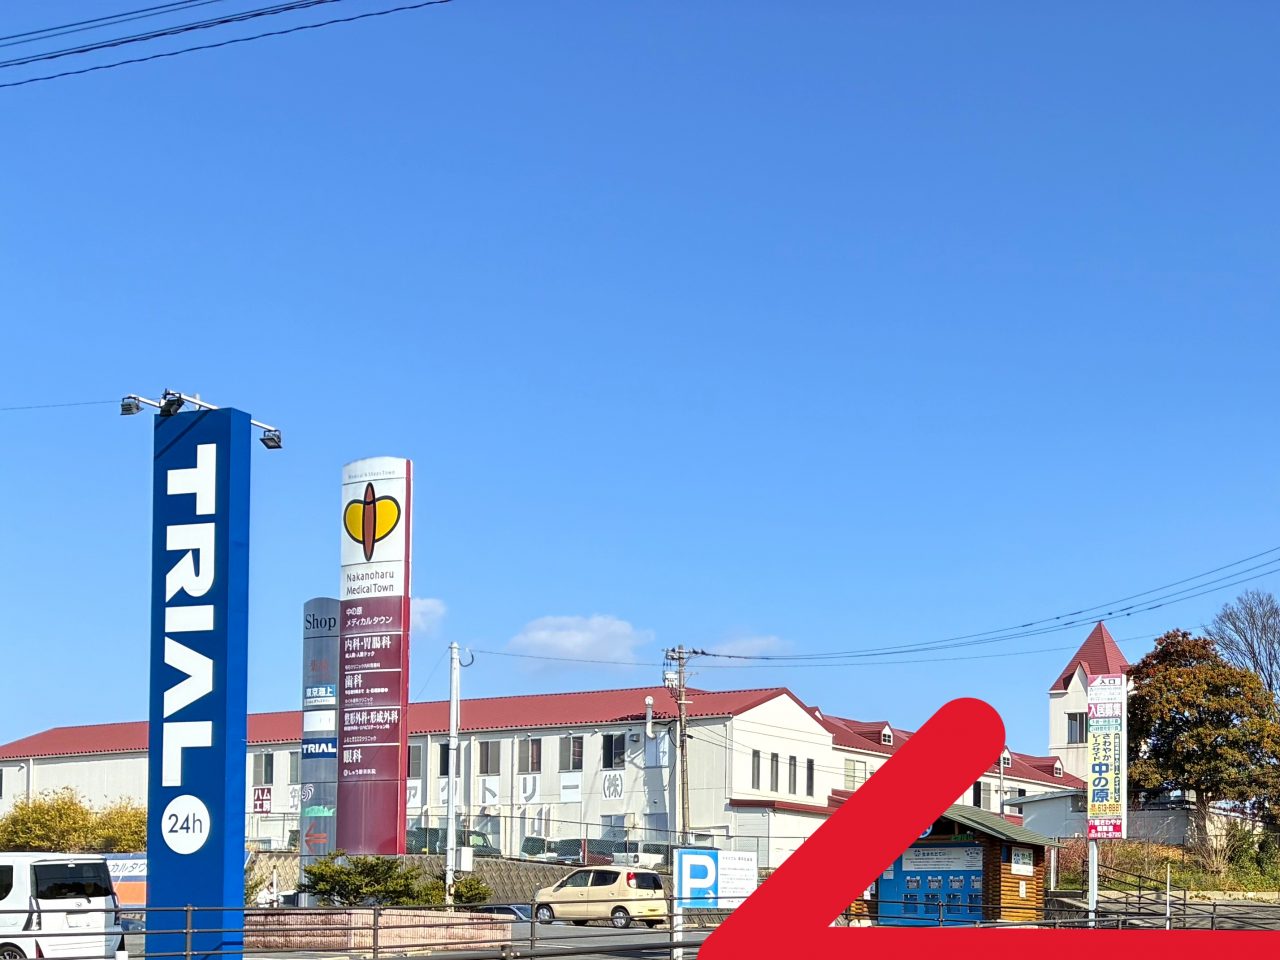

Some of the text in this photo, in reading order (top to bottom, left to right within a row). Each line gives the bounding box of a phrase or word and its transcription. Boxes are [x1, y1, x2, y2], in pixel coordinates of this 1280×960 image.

[346, 570, 394, 583] Nakanoharu
[346, 584, 394, 596] Medical Town
[162, 443, 216, 787] TRIAL
[305, 613, 337, 631] Shop
[346, 616, 393, 628] メディカルタウン
[345, 674, 362, 689] 歯科
[302, 743, 337, 754] TRIAL
[1102, 733, 1111, 761] さわやか
[343, 748, 362, 764] 眼科
[1092, 762, 1110, 803] 中の原
[254, 788, 271, 800] ハム
[254, 801, 271, 812] 工房
[168, 813, 203, 834] 24h
[682, 854, 716, 903] P
